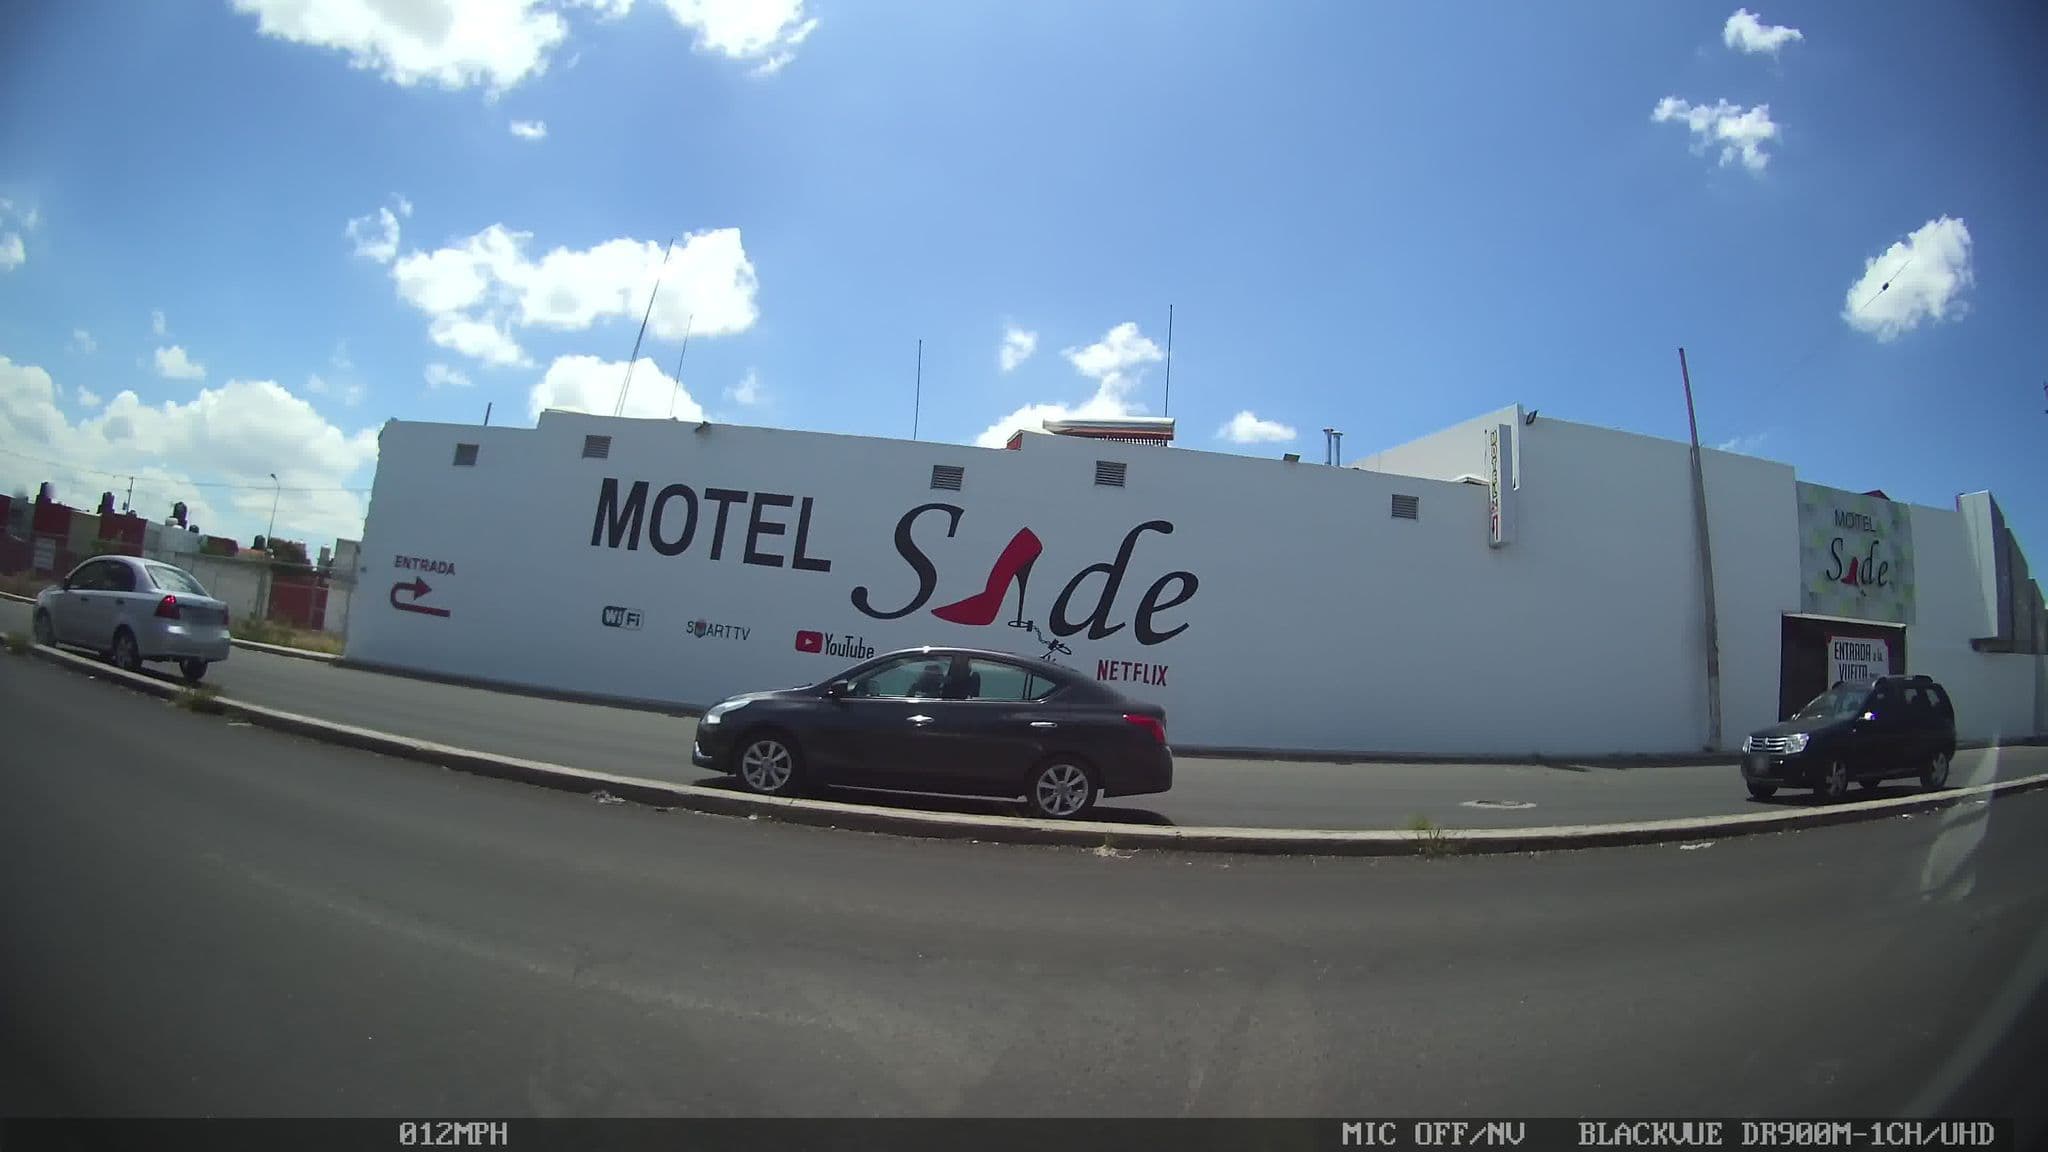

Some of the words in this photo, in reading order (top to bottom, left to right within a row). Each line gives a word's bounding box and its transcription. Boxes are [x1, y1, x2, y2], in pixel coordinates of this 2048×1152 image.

[590, 477, 832, 573] MOTEL
[1834, 509, 1877, 533] MOTEL
[394, 554, 456, 576] ENTRADA
[850, 502, 1200, 646] Sde
[824, 632, 875, 660] YouTube
[1834, 641, 1871, 662] ENTRADA
[1097, 658, 1169, 687] NETFLIX
